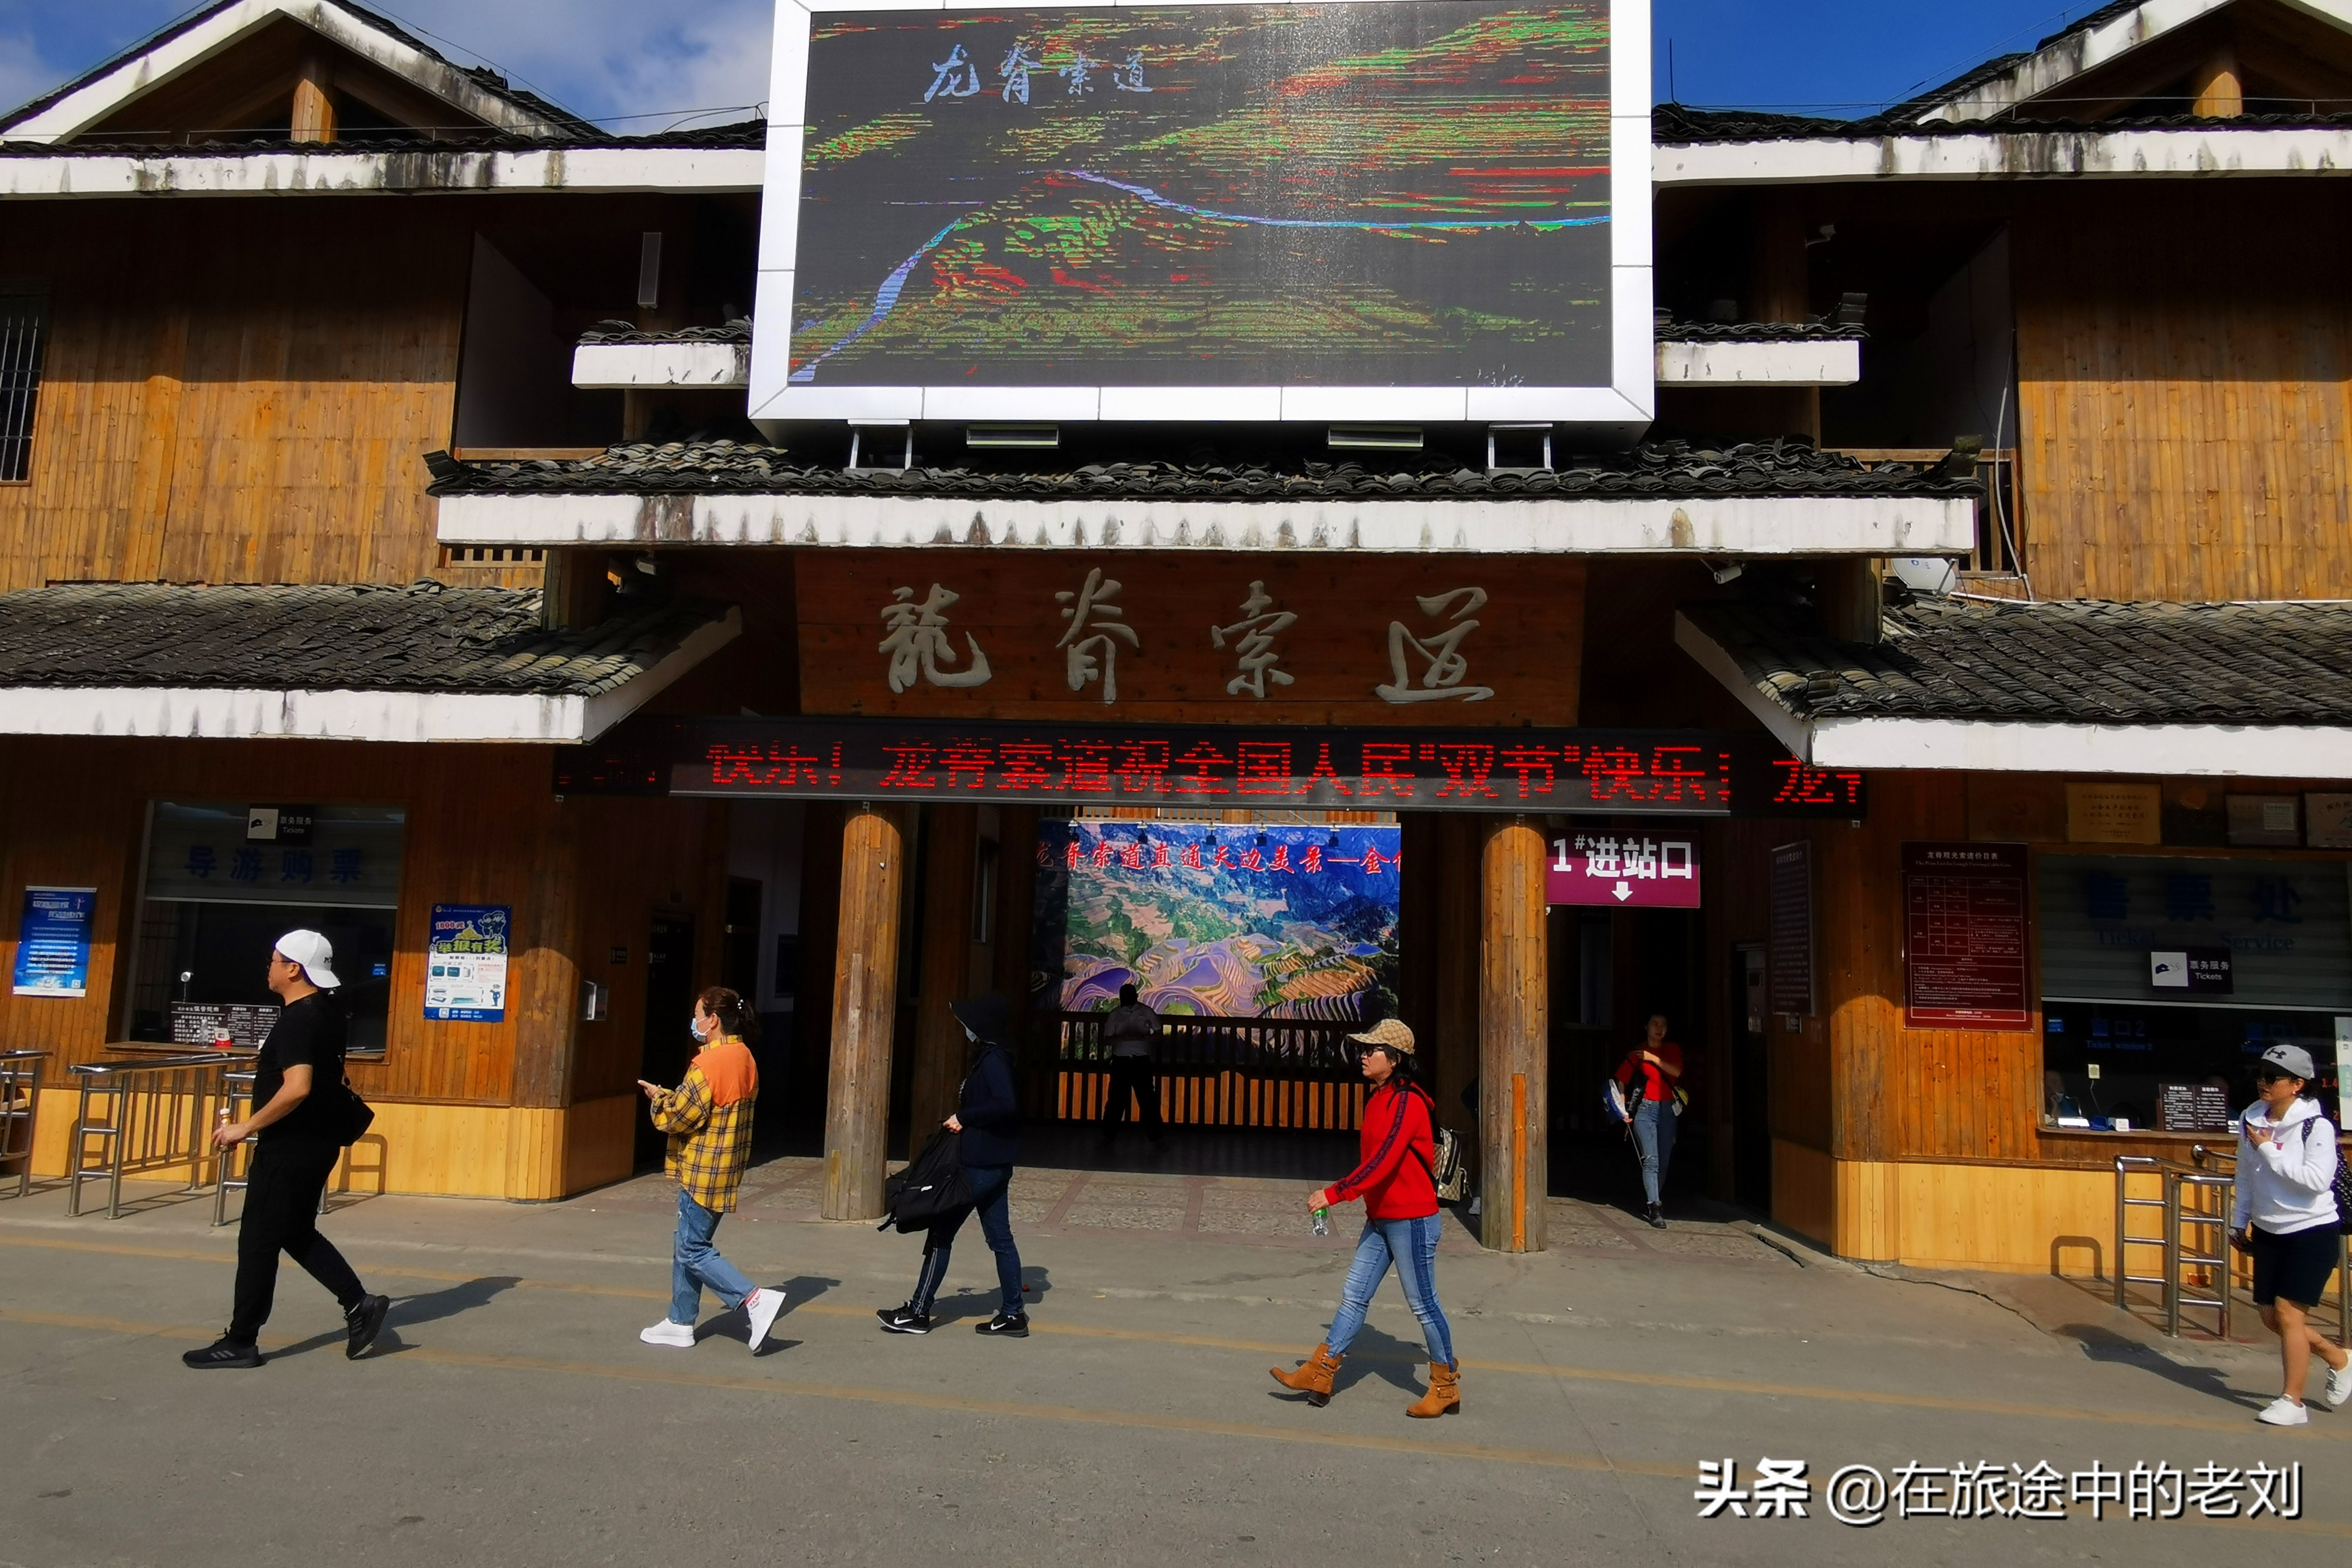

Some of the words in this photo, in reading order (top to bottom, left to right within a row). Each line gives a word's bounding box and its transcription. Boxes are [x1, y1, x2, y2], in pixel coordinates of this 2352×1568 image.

[924, 43, 1153, 105] 龙脊索道
[1772, 755, 1861, 803] 龙
[280, 815, 312, 826] 票务服务
[184, 845, 362, 883] 导游购票
[1036, 841, 1401, 874] 龙脊索道直通天边美景—金
[1553, 834, 1692, 880] 1#进站口
[2083, 871, 2303, 924] 售票处
[436, 921, 465, 929] 1000元
[438, 939, 502, 954] 举报有奖
[2095, 929, 2155, 946] Ticket
[2219, 933, 2294, 950] Service
[2189, 959, 2229, 970] 票务服务
[2195, 972, 2222, 981] Tickets
[2085, 1040, 2112, 1049] Ticket
